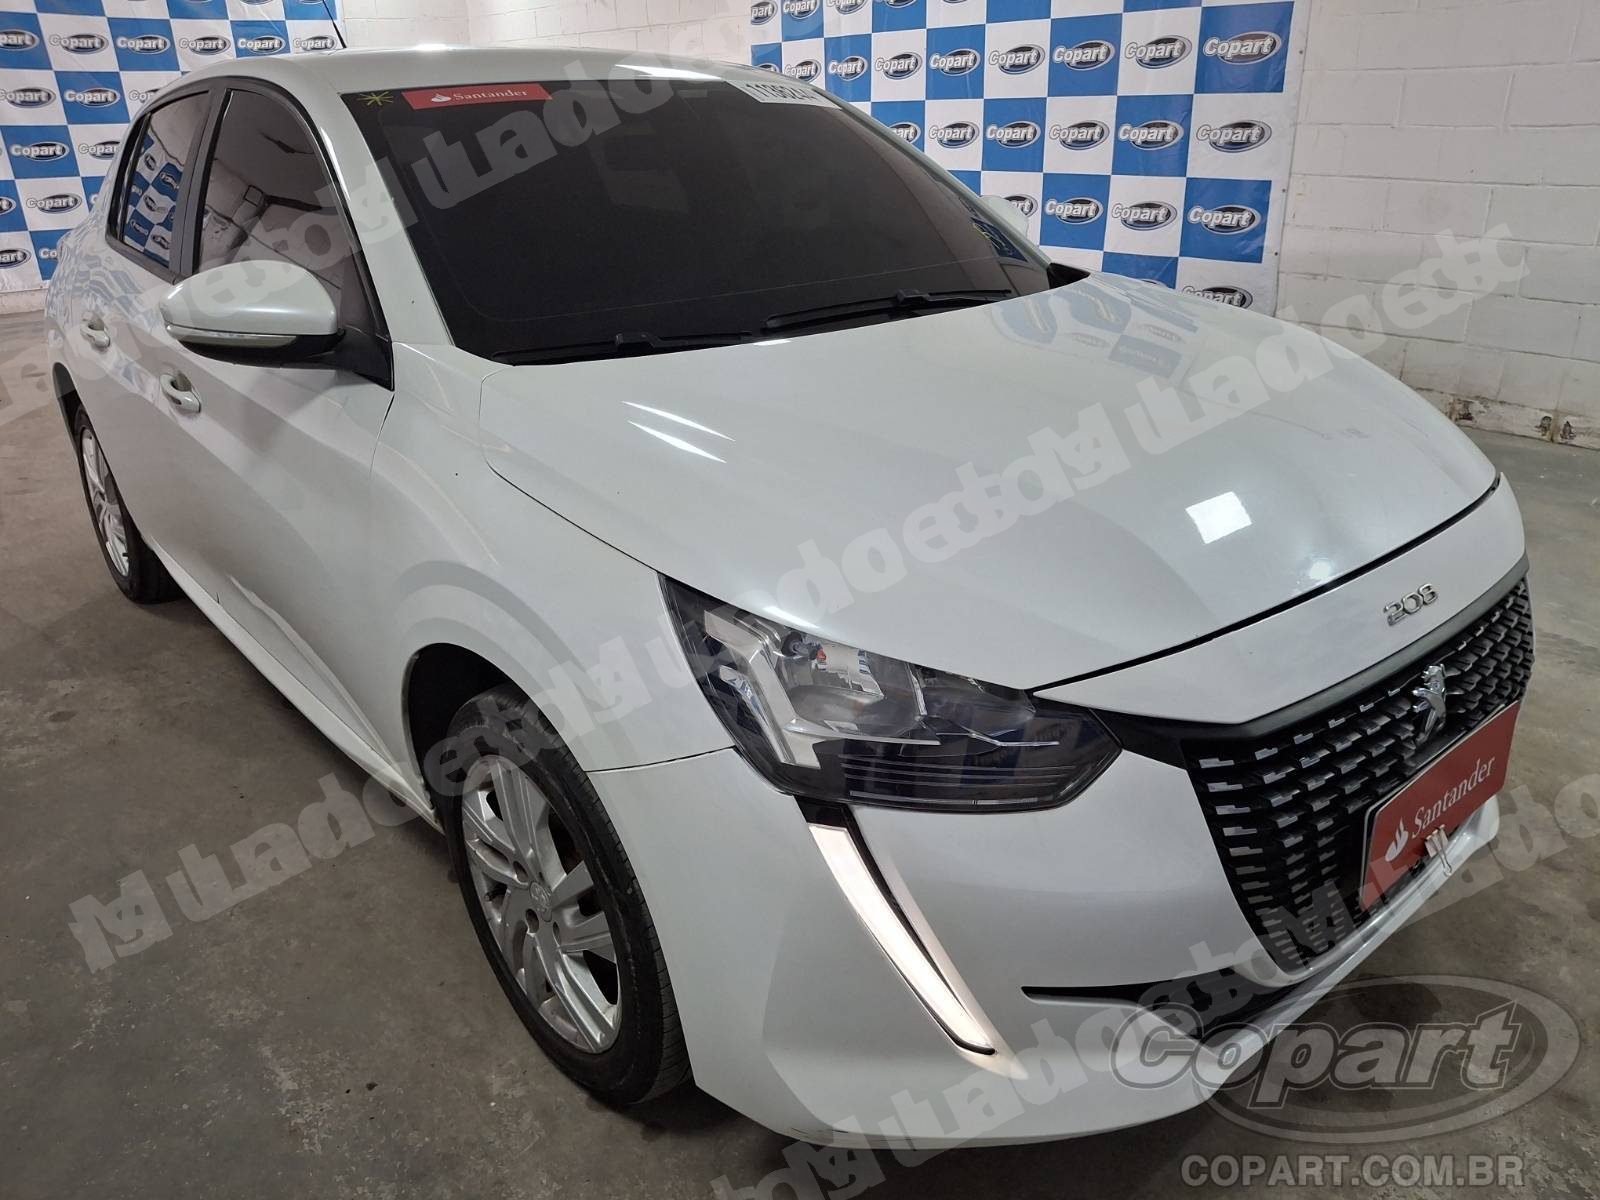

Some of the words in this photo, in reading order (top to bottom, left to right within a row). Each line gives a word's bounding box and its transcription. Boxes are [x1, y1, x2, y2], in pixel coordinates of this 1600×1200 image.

[751, 4, 773, 17] part
[0, 32, 33, 48] part
[50, 35, 101, 51] Copart
[116, 36, 166, 51] Copart
[179, 38, 224, 49] Copart
[237, 38, 282, 49] Copart
[293, 38, 333, 48] Copart
[1203, 35, 1275, 58] Copart
[989, 48, 1038, 69] Copart
[1053, 44, 1108, 63] Copart
[1125, 41, 1184, 61] Copart
[829, 60, 863, 75] Copart
[875, 54, 916, 74] Copart
[929, 51, 976, 70] Copart
[784, 63, 817, 79] Copart
[0, 90, 49, 105] Copart
[65, 90, 117, 105] Copart
[453, 88, 528, 101] Santander
[929, 123, 975, 141] Copart
[986, 123, 1035, 142] Copart
[1049, 123, 1104, 143] Copart
[1119, 123, 1175, 143] Copart
[1196, 123, 1262, 144] Copart
[10, 144, 63, 158] Copart
[78, 143, 118, 157] Copar
[26, 196, 76, 212] Copart
[1045, 198, 1098, 217] Copart
[1111, 202, 1170, 222] Copart
[1187, 205, 1253, 228] Copart
[1383, 583, 1439, 626] 208
[1412, 756, 1495, 838] Santander
